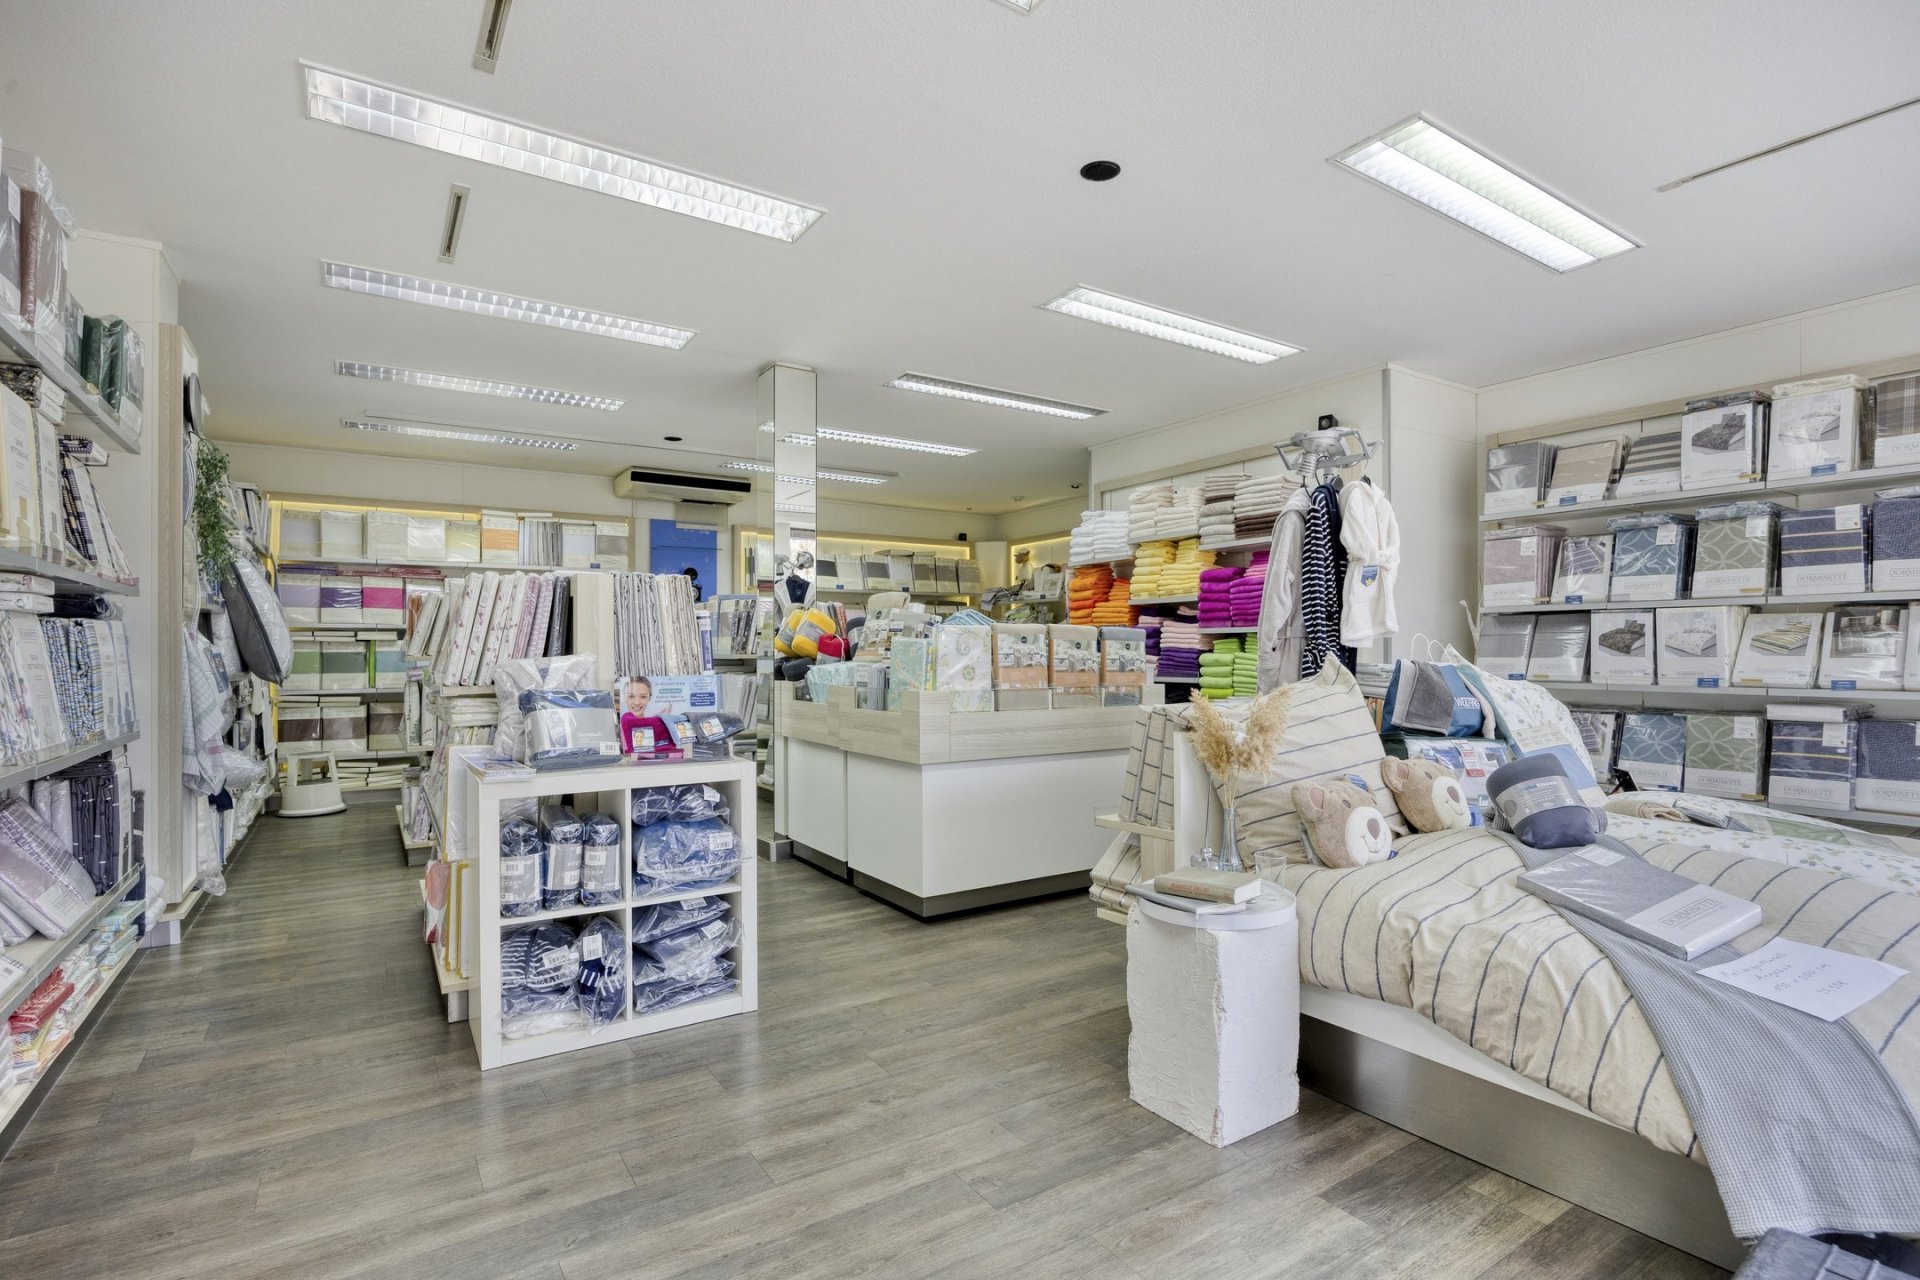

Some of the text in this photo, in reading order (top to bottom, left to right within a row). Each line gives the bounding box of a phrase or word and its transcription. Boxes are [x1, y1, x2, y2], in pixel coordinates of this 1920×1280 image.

[1796, 573, 1847, 583] DORMISETTE
[1624, 582, 1663, 591] DORMISETTE
[1698, 776, 1741, 787] DORMISETTE
[1783, 785, 1833, 797] DORMISETTE
[1662, 898, 1719, 926] DORMISETTE
